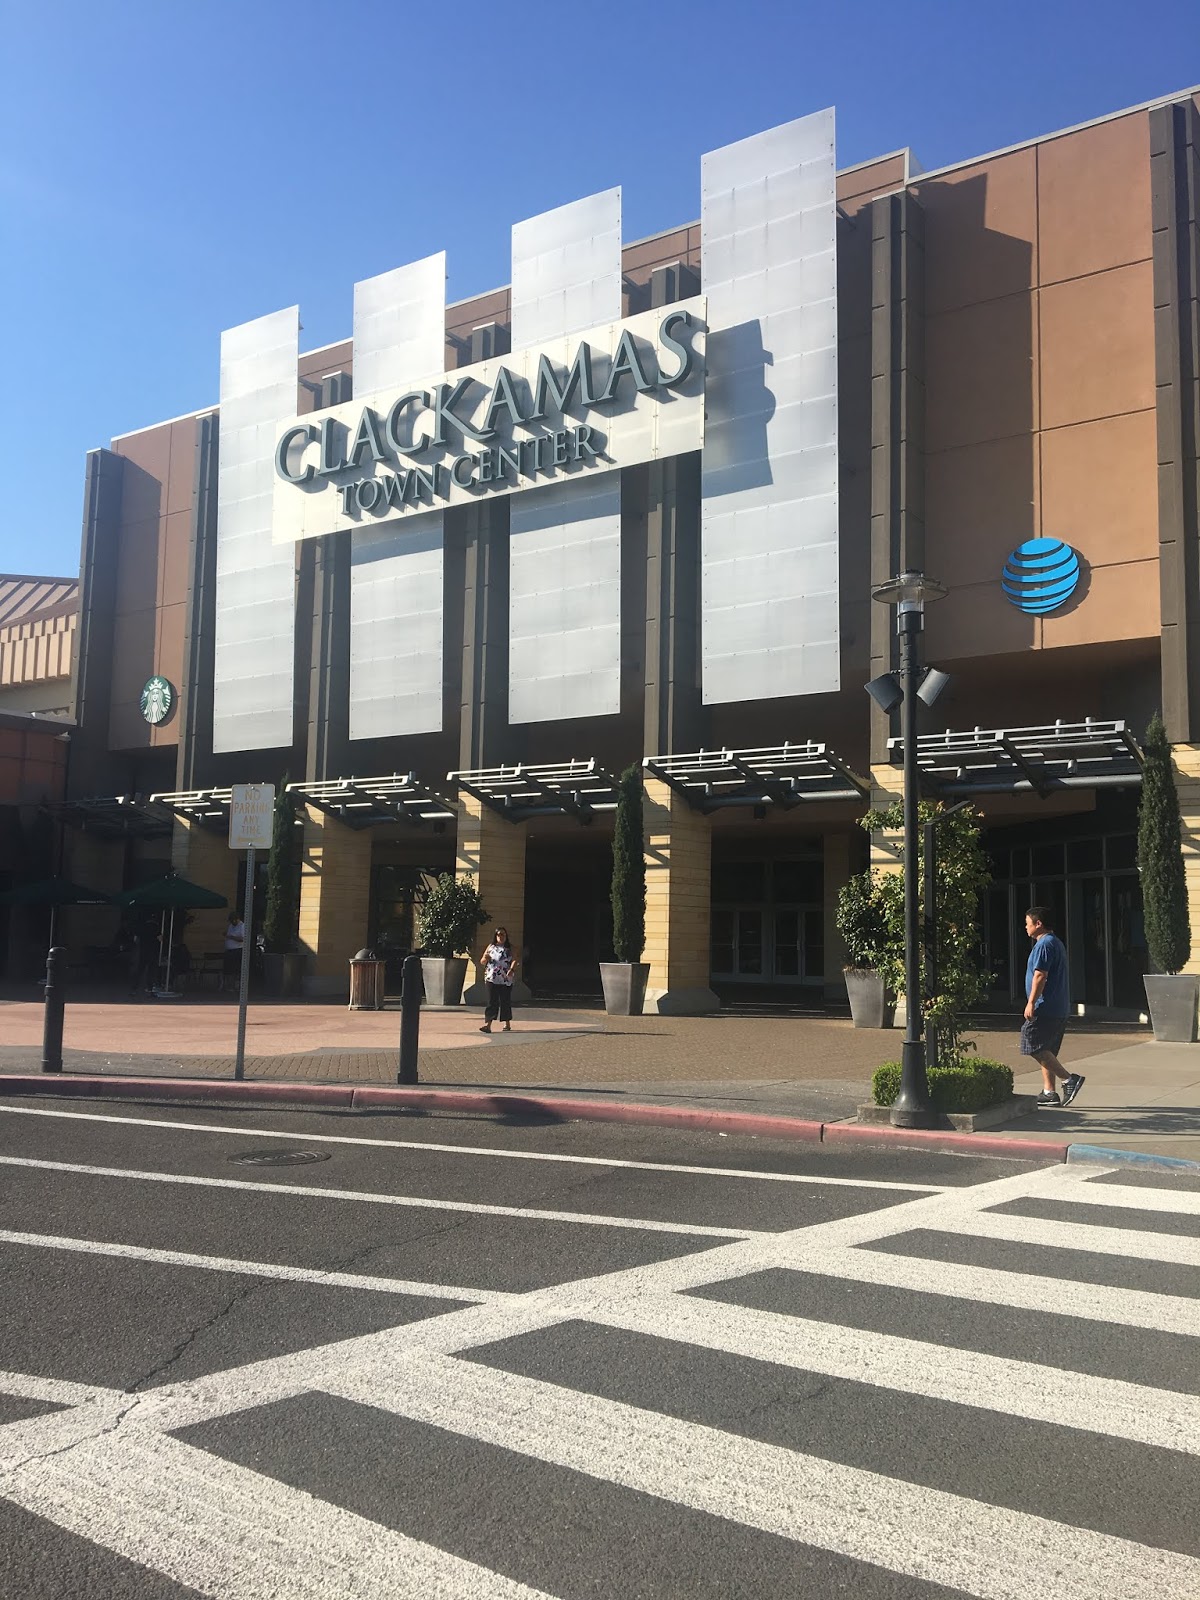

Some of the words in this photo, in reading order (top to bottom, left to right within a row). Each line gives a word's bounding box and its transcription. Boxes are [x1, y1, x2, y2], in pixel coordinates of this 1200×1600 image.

[274, 309, 693, 484] CLACKAMAS
[336, 463, 440, 516] TOWN
[450, 422, 600, 489] CENTER
[245, 789, 261, 801] NO
[243, 815, 260, 825] ANY
[241, 825, 262, 836] TIME
